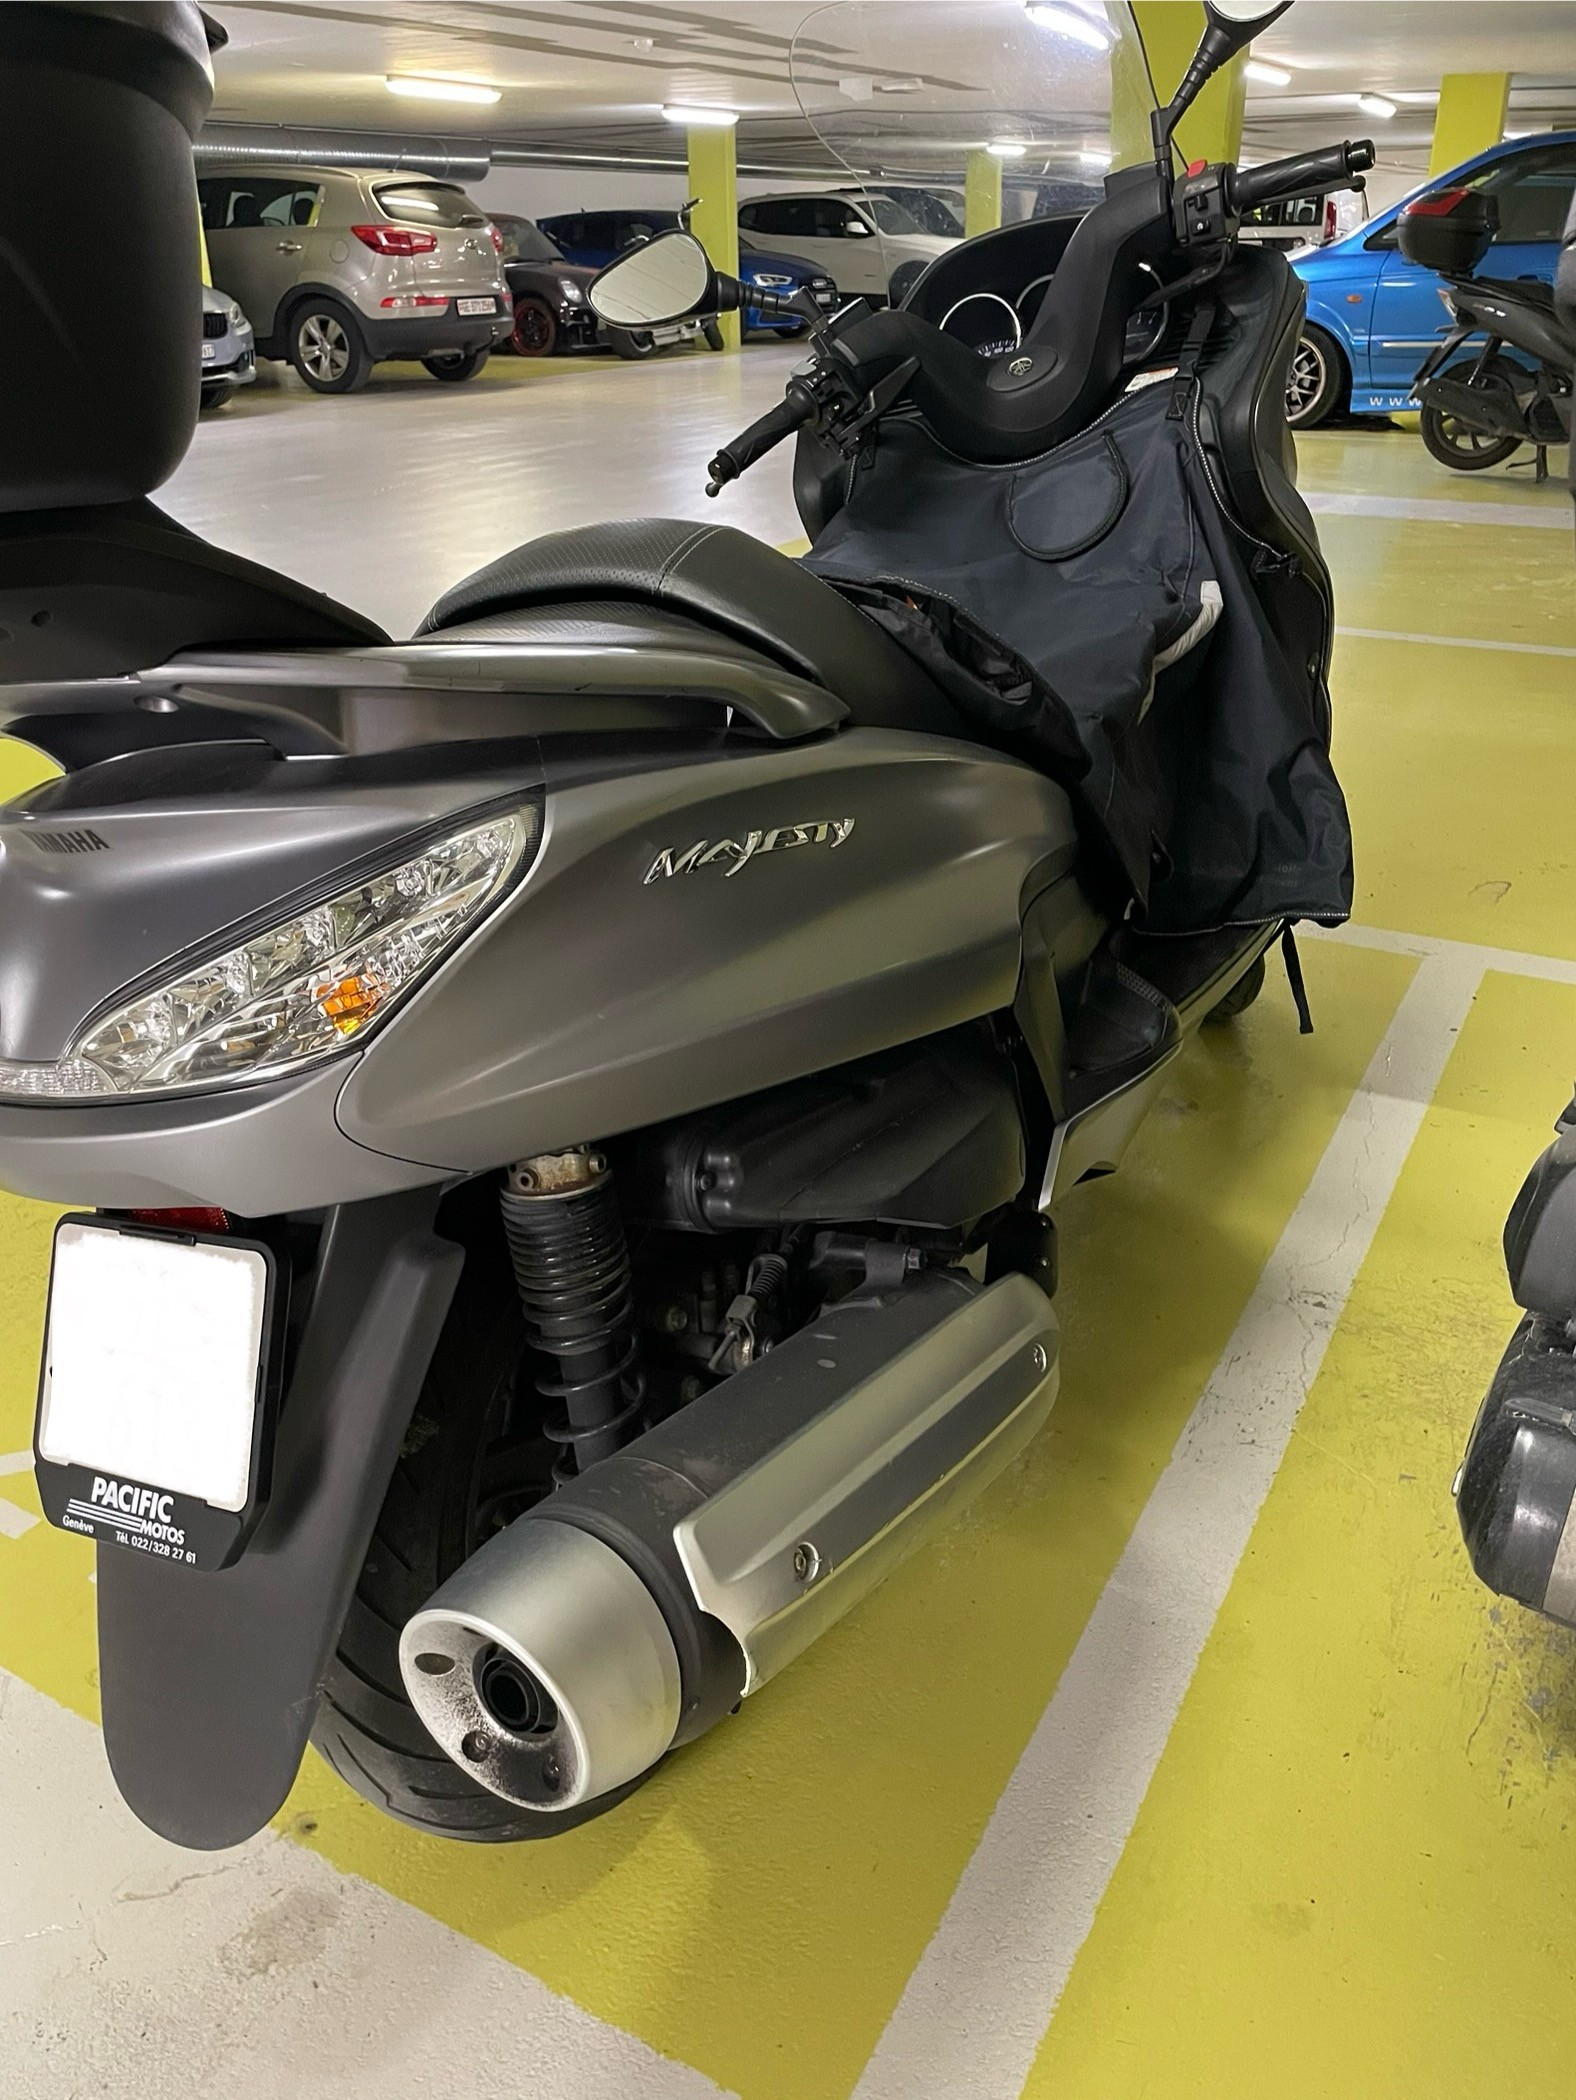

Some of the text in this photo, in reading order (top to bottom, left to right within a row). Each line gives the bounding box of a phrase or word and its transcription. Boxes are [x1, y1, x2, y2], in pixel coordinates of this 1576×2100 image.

[91, 1476, 174, 1523] PACIFIC
[62, 1514, 94, 1534] Genève
[140, 1519, 185, 1545] MOTOS
[131, 1535, 170, 1556] 022/328
[172, 1546, 184, 1560] 27
[186, 1550, 196, 1564] 61
